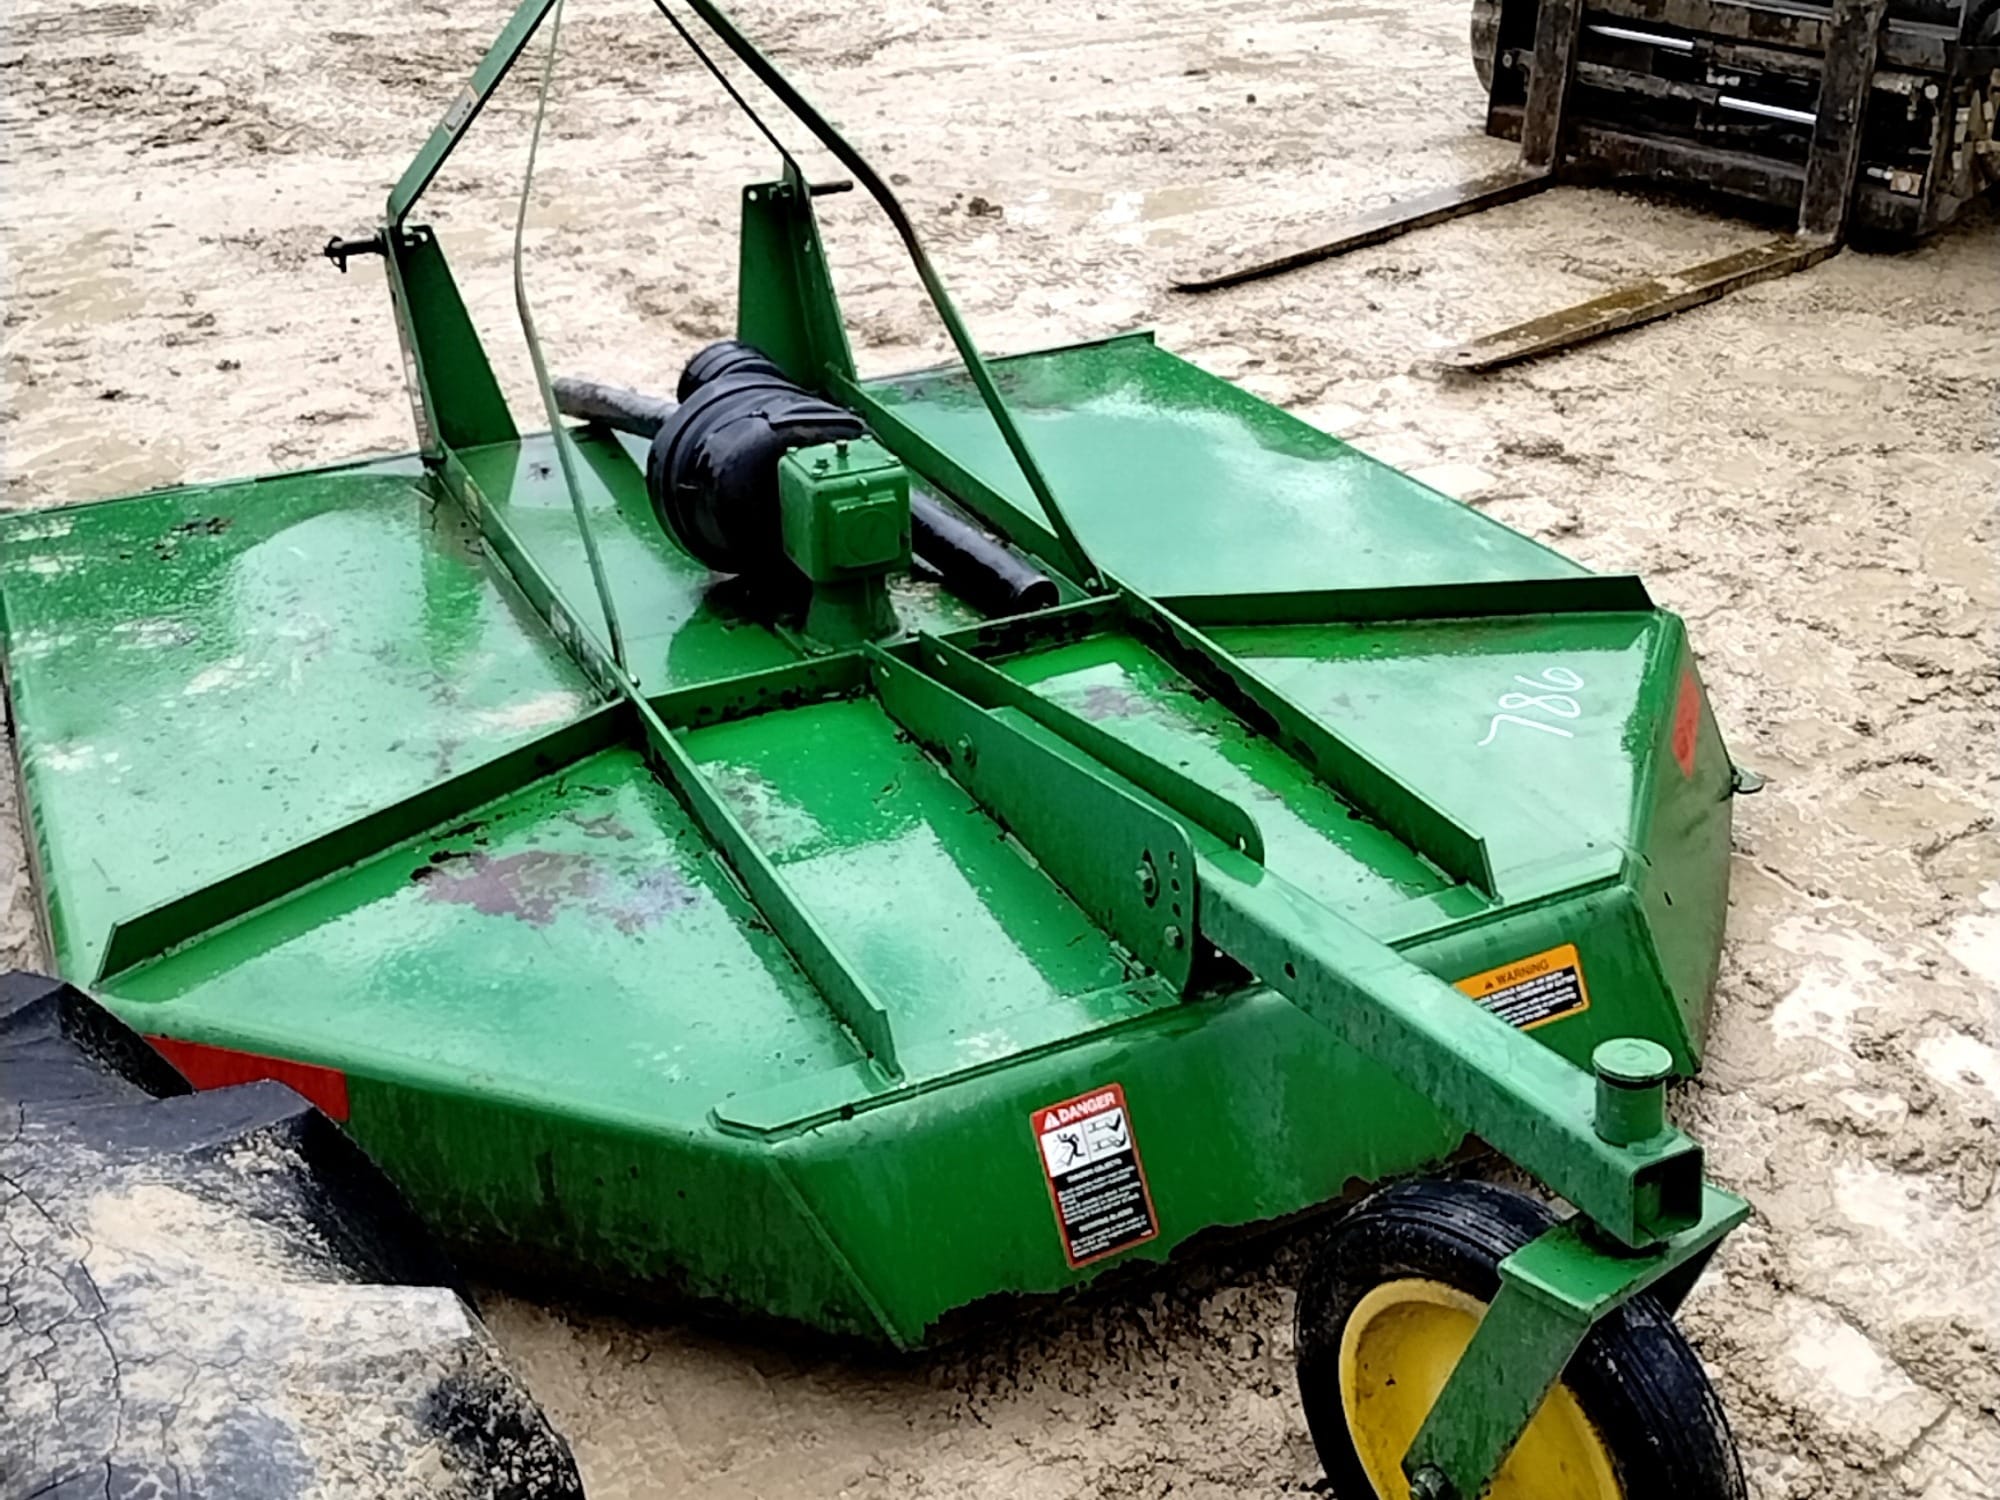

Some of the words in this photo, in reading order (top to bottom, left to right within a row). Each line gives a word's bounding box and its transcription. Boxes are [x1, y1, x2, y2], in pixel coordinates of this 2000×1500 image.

[1477, 666, 1584, 746] 786
[1495, 959, 1549, 984] WARNING
[1057, 1092, 1116, 1123] DANGER
